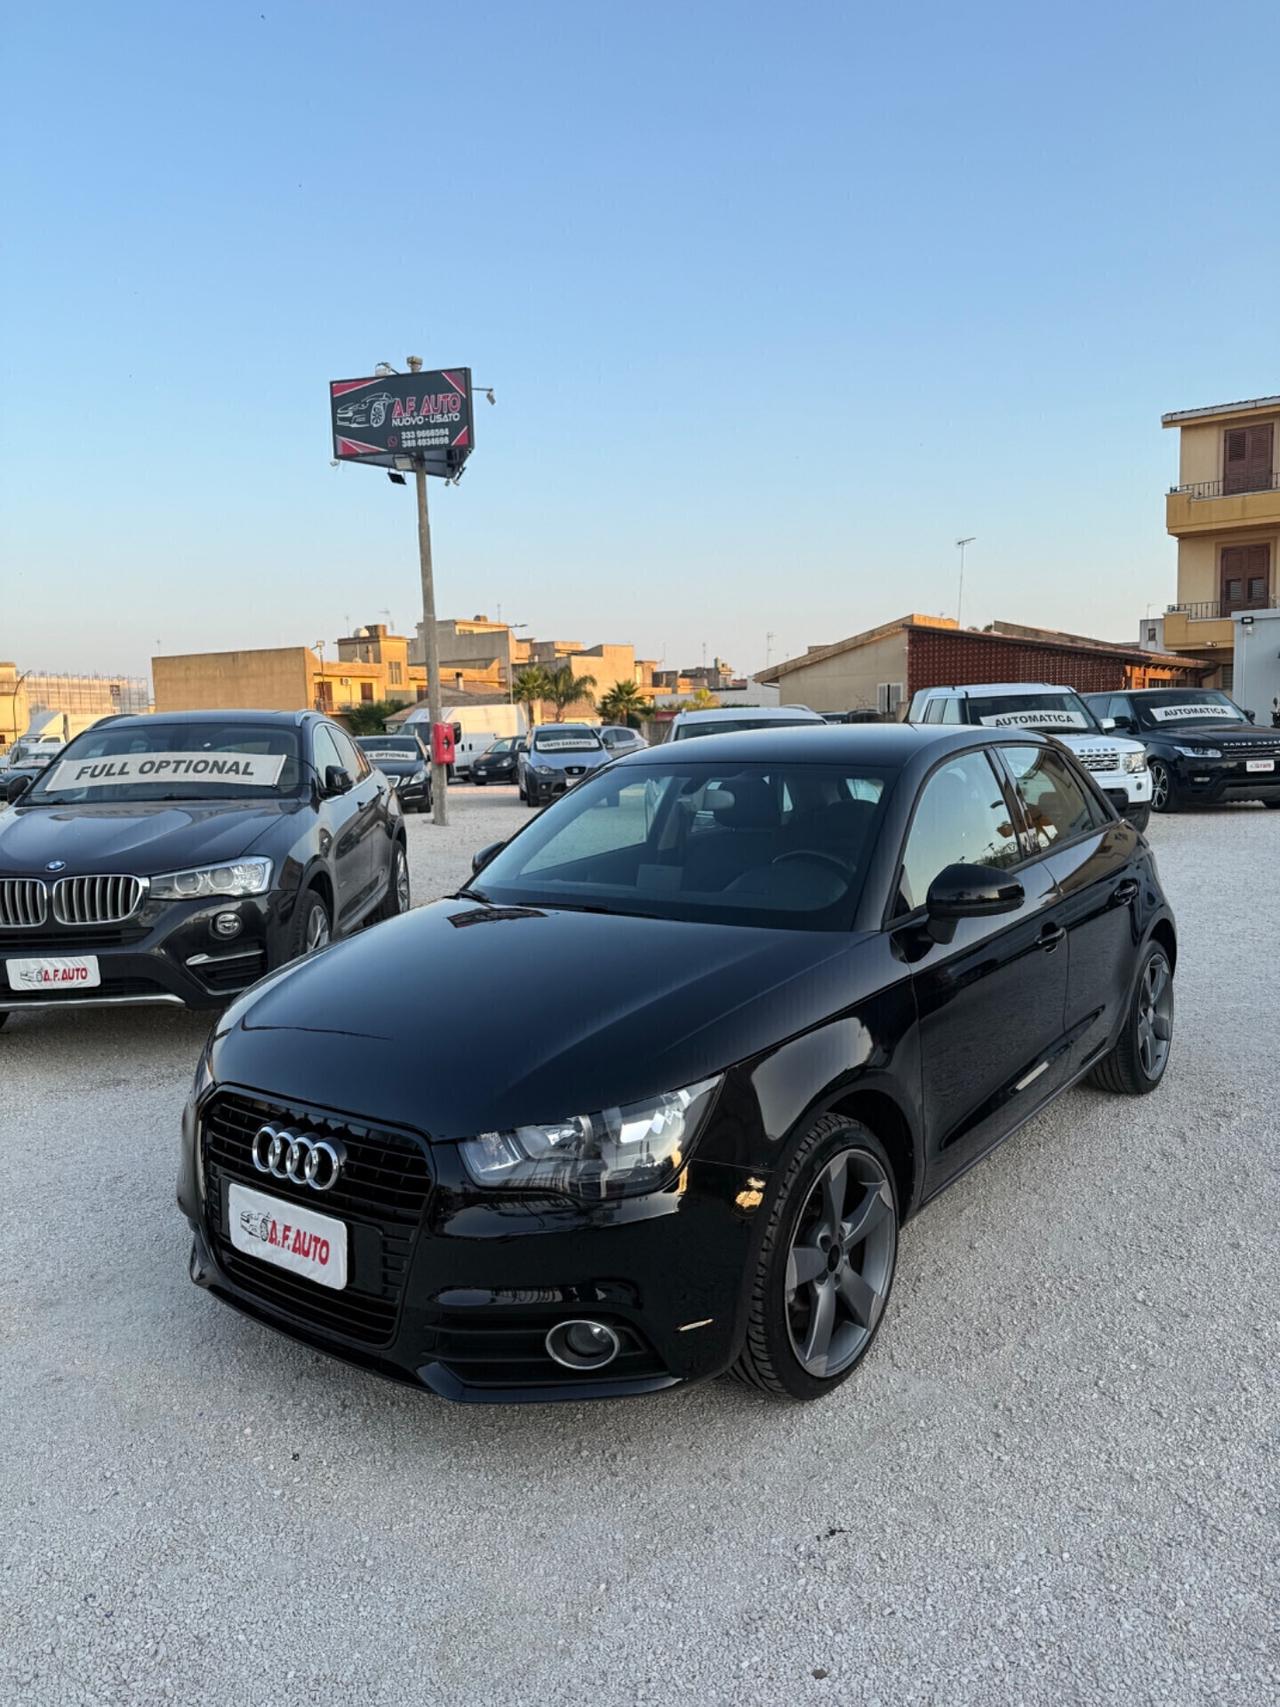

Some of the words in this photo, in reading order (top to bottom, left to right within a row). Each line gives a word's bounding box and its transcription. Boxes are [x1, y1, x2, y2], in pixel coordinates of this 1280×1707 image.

[420, 392, 461, 416] AUTO
[392, 416, 424, 427] NUOVO
[429, 413, 460, 423] USATO
[1164, 707, 1228, 717] AUTOMATICA
[995, 714, 1074, 727] AUTOMATICA
[75, 762, 130, 780] FULL
[138, 760, 254, 775] OPTIONAL
